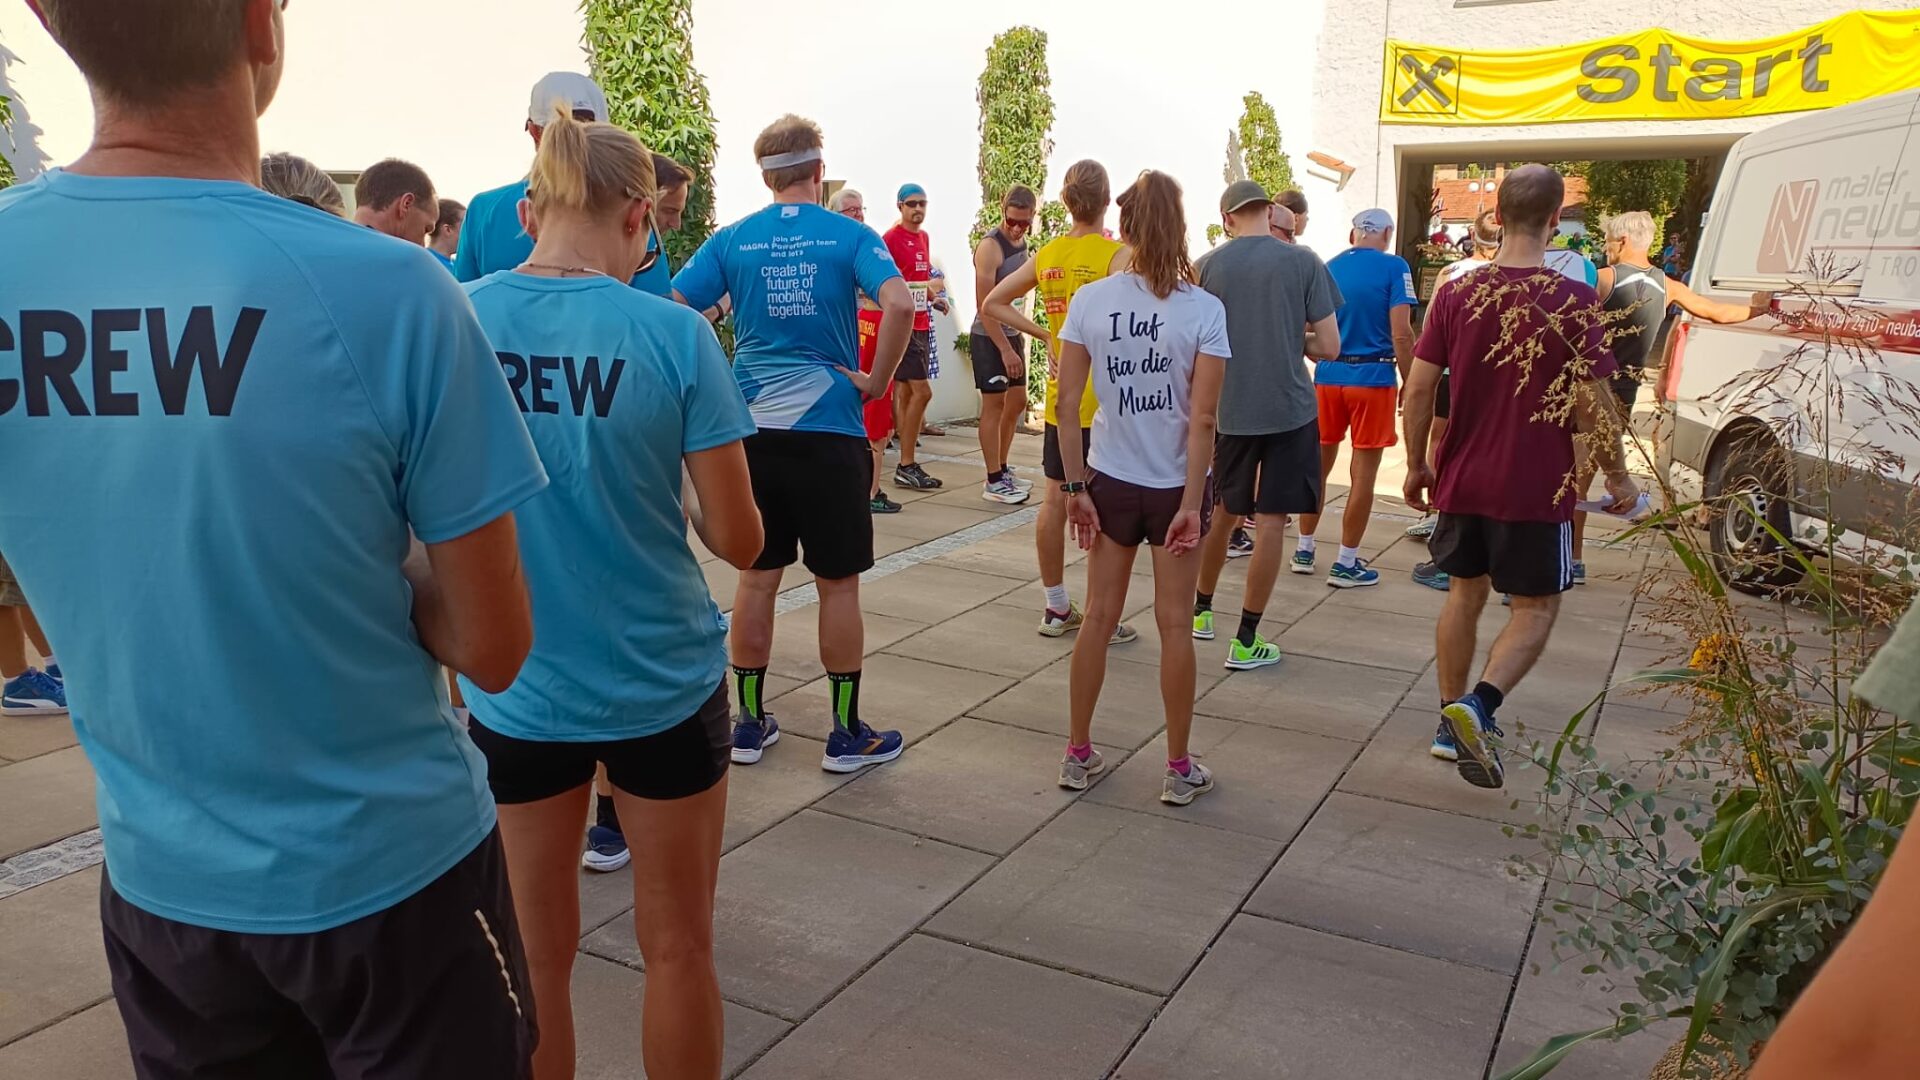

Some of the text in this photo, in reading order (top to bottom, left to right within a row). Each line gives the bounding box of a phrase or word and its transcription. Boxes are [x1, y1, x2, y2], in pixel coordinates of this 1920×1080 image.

[1577, 34, 1832, 103] Start
[1825, 166, 1909, 200] maler
[739, 242, 769, 251] MAGNA
[771, 239, 814, 249] Powertrain
[761, 261, 817, 277] create the
[766, 275, 814, 290] future of
[767, 289, 814, 305] mobility,
[768, 302, 818, 319] together.
[1109, 311, 1164, 342] I laf
[1107, 347, 1172, 384] fia die
[494, 351, 626, 418] REW
[1119, 384, 1173, 417] Musi!
